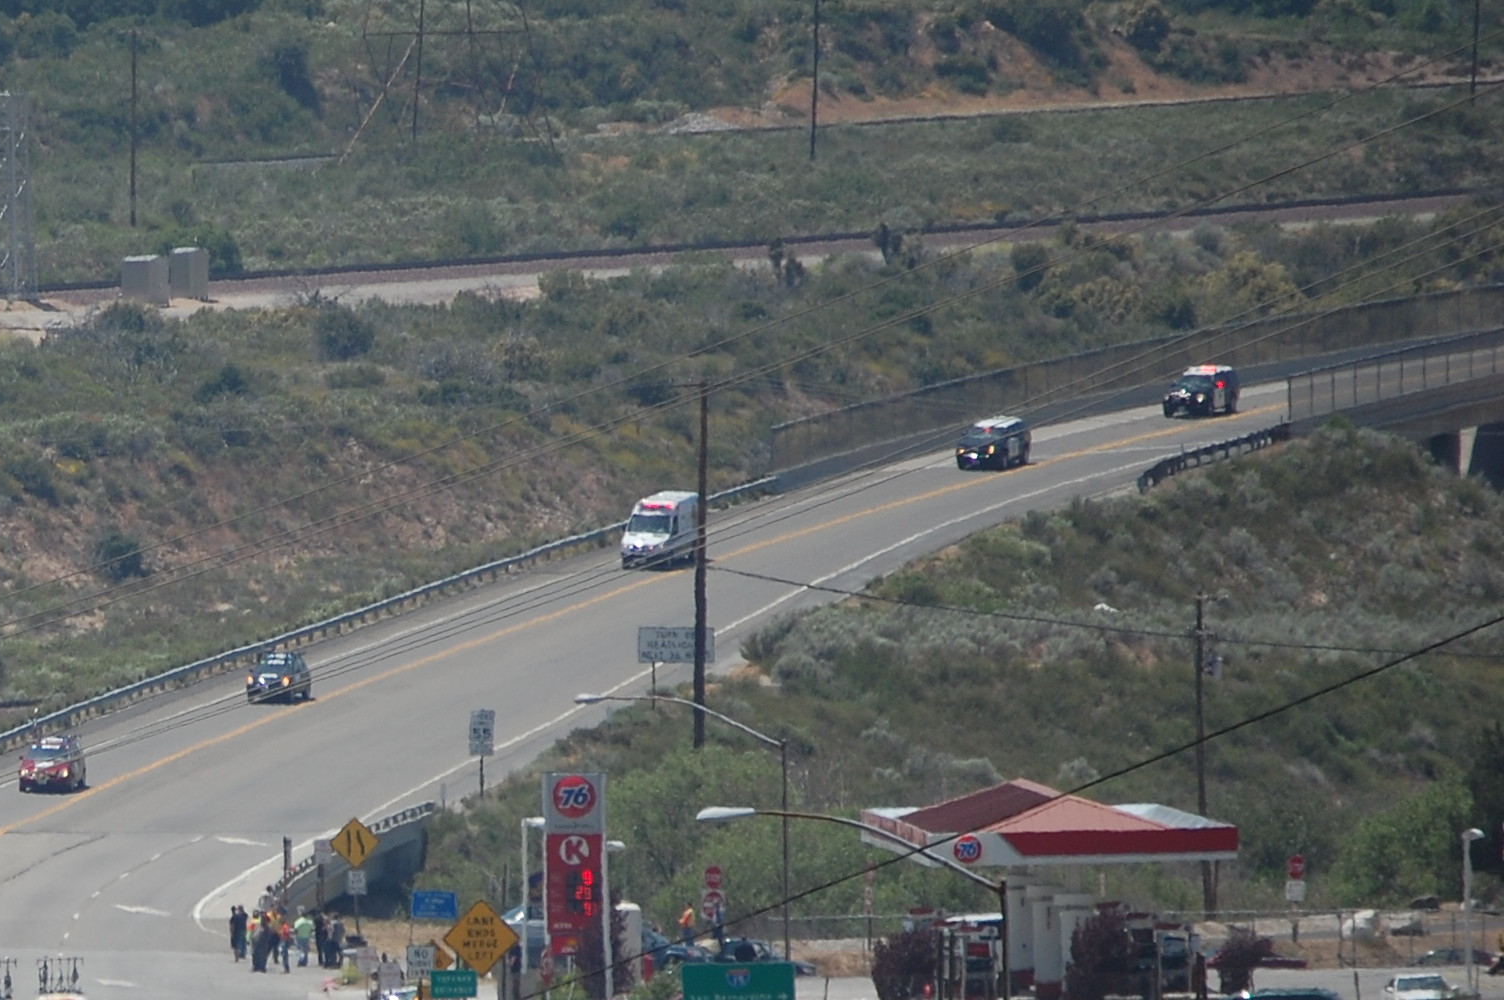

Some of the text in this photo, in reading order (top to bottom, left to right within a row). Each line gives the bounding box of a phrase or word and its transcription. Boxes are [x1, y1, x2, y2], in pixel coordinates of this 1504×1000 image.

[558, 784, 590, 809] 76
[957, 842, 977, 859] 76
[414, 950, 429, 959] NO
